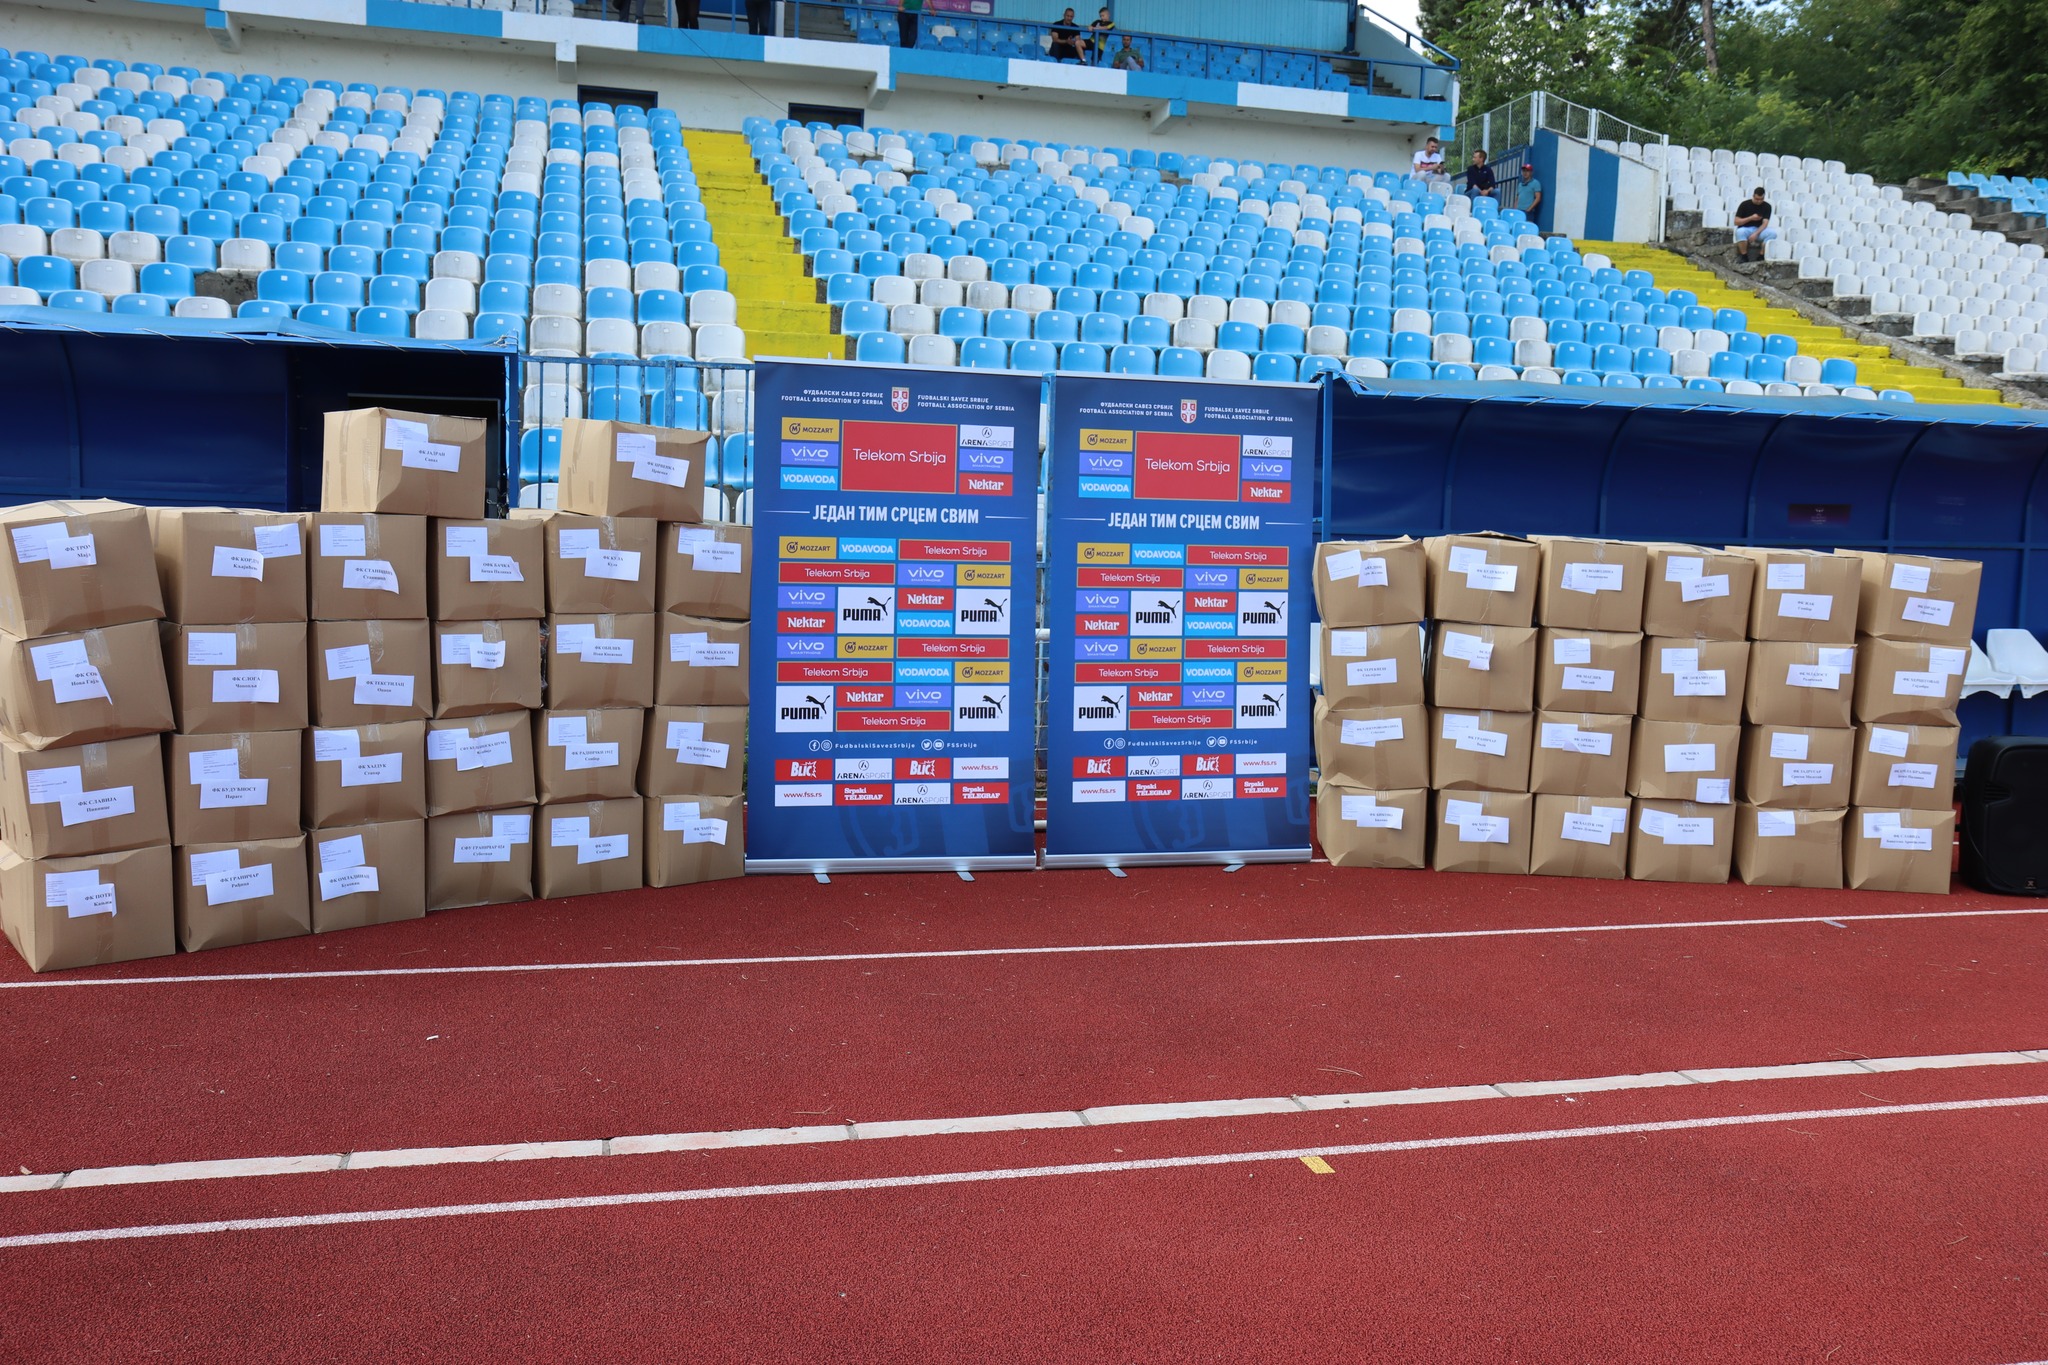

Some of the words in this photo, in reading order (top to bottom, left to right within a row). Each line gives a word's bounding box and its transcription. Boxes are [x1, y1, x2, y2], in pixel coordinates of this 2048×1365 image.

[841, 390, 860, 398] САВЕЗ
[812, 396, 852, 404] ASSOCIATION
[946, 402, 984, 410] ASSOCIATION
[802, 426, 833, 434] MOZZART
[791, 446, 829, 458] vivo
[852, 449, 906, 462] Telekom
[909, 449, 946, 465] Srbija
[969, 452, 1004, 465] vivo
[1089, 457, 1123, 468] vivo
[1145, 458, 1193, 471] Telekom
[1196, 460, 1230, 474] Srbija
[1251, 462, 1283, 473] vivo
[783, 474, 836, 484] VODAVODA
[968, 479, 1004, 490] Nektar
[1081, 483, 1129, 493] VODAVODA
[1250, 487, 1283, 498] Nektar
[812, 505, 855, 523] ЈЕДАН
[859, 506, 887, 522] ТИМ
[891, 507, 936, 524] СРЦЕМ
[940, 508, 979, 523] СВИМ
[1108, 512, 1147, 529] ЈЕДАН
[1150, 514, 1176, 528] ТИМ
[1179, 515, 1222, 530] СРЦЕМ
[1225, 516, 1260, 530] СВИМ
[841, 543, 894, 554] VODAVODA
[924, 545, 960, 556] Telekom
[962, 546, 987, 557] Srbija
[1134, 550, 1182, 559] VODAVODA
[1209, 551, 1242, 560] Telekom
[1244, 551, 1267, 561] Srbija
[805, 568, 842, 578] Telekom
[843, 568, 870, 579] Srbija
[908, 566, 944, 578] vivo
[1195, 571, 1228, 582] vivo
[1100, 573, 1134, 582] Telekom
[1136, 573, 1160, 583] Srbija
[788, 589, 826, 601] vivo
[907, 593, 944, 605] Nektar
[1085, 594, 1120, 605] vivo
[1194, 597, 1228, 608] Nektar
[843, 608, 881, 622] PUMA
[961, 610, 997, 622] PUMA
[1136, 611, 1171, 624] PUMA
[1243, 612, 1276, 624] PUMA
[787, 617, 826, 628] Nektar
[899, 619, 951, 628] VODAVODA
[1084, 620, 1120, 631] Nektar
[1187, 621, 1233, 630] VODAVODA
[787, 639, 825, 651] vivo
[922, 643, 958, 653] Telekom
[960, 643, 985, 654] Srbija
[1084, 641, 1118, 652] vivo
[1208, 645, 1240, 654] Telekom
[1242, 645, 1265, 655] Srbija
[803, 667, 840, 677] Telekom
[842, 667, 868, 678] Srbija
[898, 668, 950, 677] VODAVODA
[1099, 668, 1133, 677] Telekom
[1134, 668, 1159, 678] Srbija
[1186, 668, 1232, 677] VODAVODA
[846, 691, 884, 703] Nektar
[905, 688, 942, 700] vivo
[1138, 691, 1173, 702] Nektar
[1192, 688, 1225, 699] vivo
[781, 707, 820, 720] PUMA
[959, 706, 996, 719] PUMA
[1079, 707, 1114, 719] PUMA
[1241, 704, 1275, 717] PUMA
[862, 716, 898, 726] Telekom
[900, 716, 926, 727] Srbija
[1152, 715, 1186, 724] Telekom
[1187, 714, 1211, 725] Srbija
[783, 791, 823, 799] www.fss.rs
